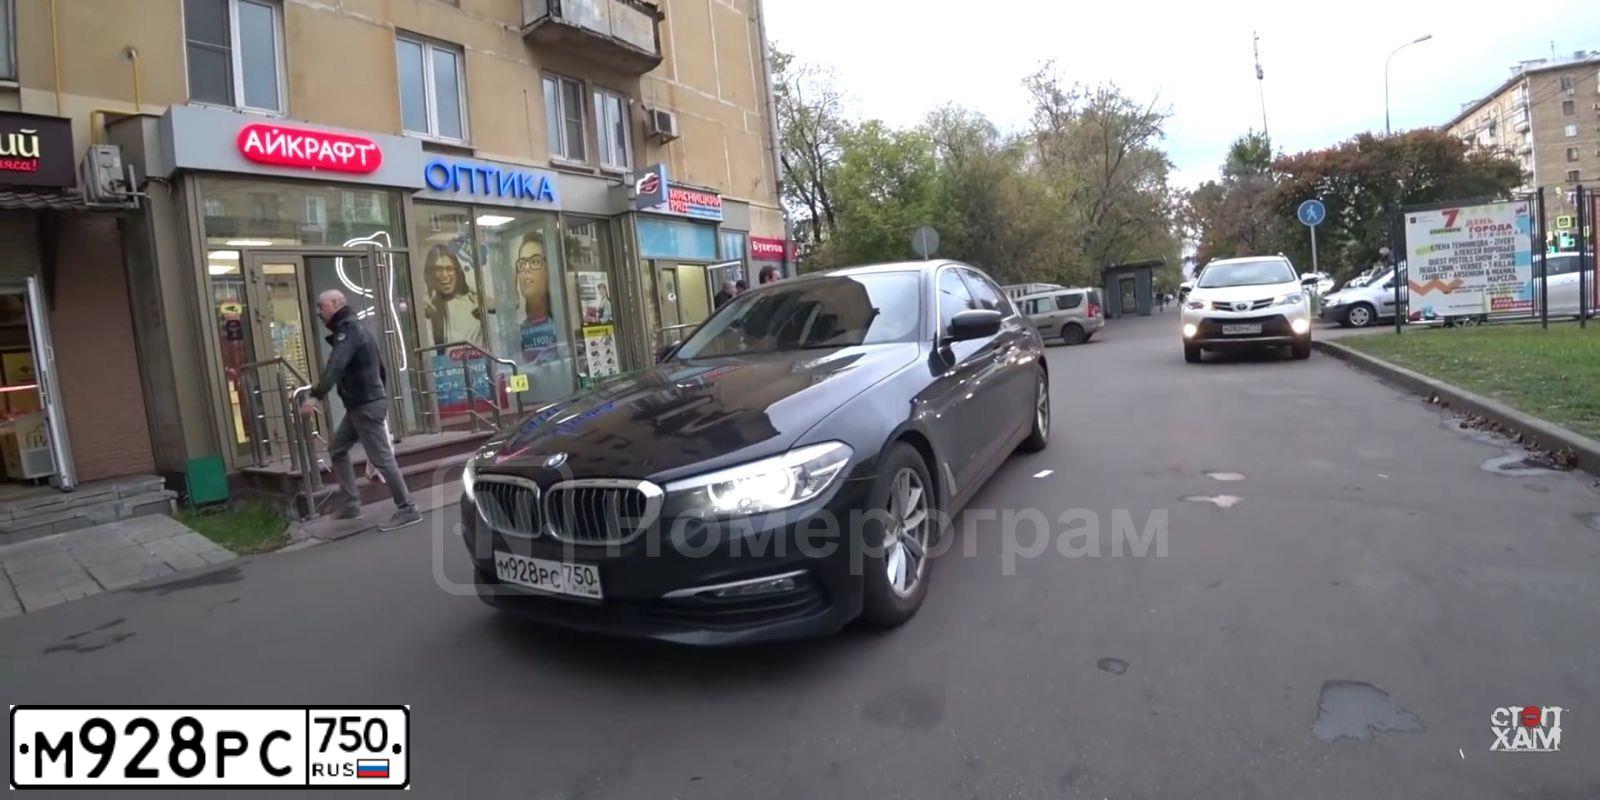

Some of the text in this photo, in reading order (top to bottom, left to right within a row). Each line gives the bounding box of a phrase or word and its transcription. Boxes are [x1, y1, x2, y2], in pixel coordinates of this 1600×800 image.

[245, 129, 369, 166] АЙКРАФТ
[424, 160, 554, 202] ОПТИКА
[668, 200, 688, 213] РЯД
[1441, 208, 1460, 229] 7
[1466, 218, 1493, 227] ДЕНЬ
[1468, 223, 1513, 233] ГОРОДА
[1430, 241, 1451, 252] ЕЛЕНА
[499, 557, 560, 588] М928РС
[563, 565, 594, 586] 750
